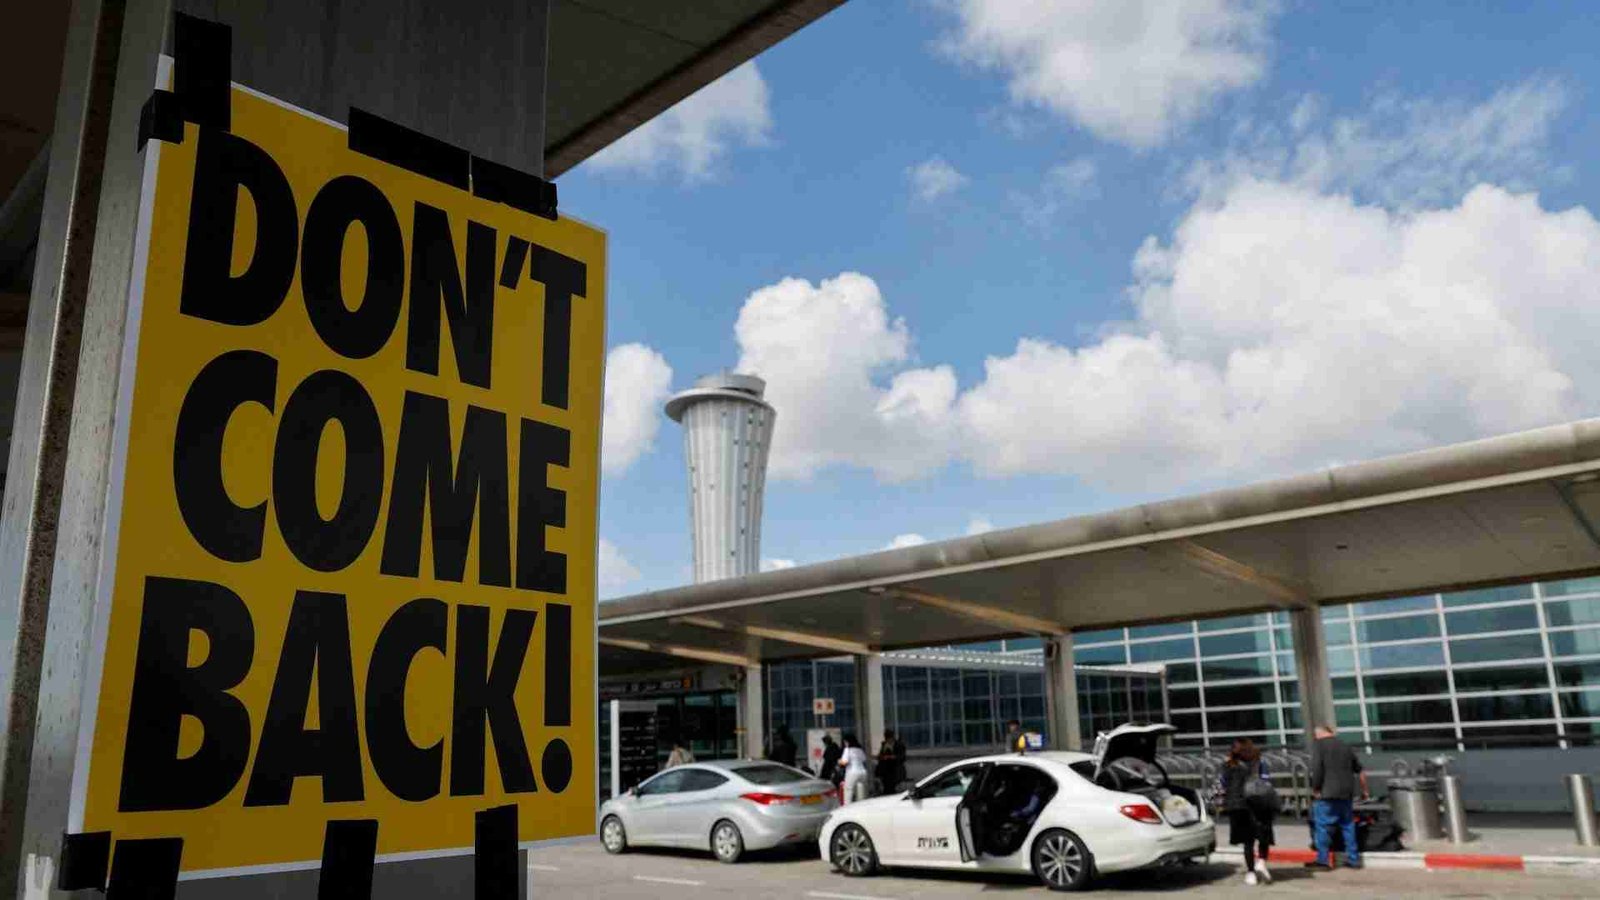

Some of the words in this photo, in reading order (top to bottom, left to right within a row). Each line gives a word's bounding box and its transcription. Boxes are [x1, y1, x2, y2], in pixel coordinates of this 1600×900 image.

[180, 129, 587, 410] DON'T
[173, 349, 571, 594] COME
[118, 575, 573, 812] BACK!
